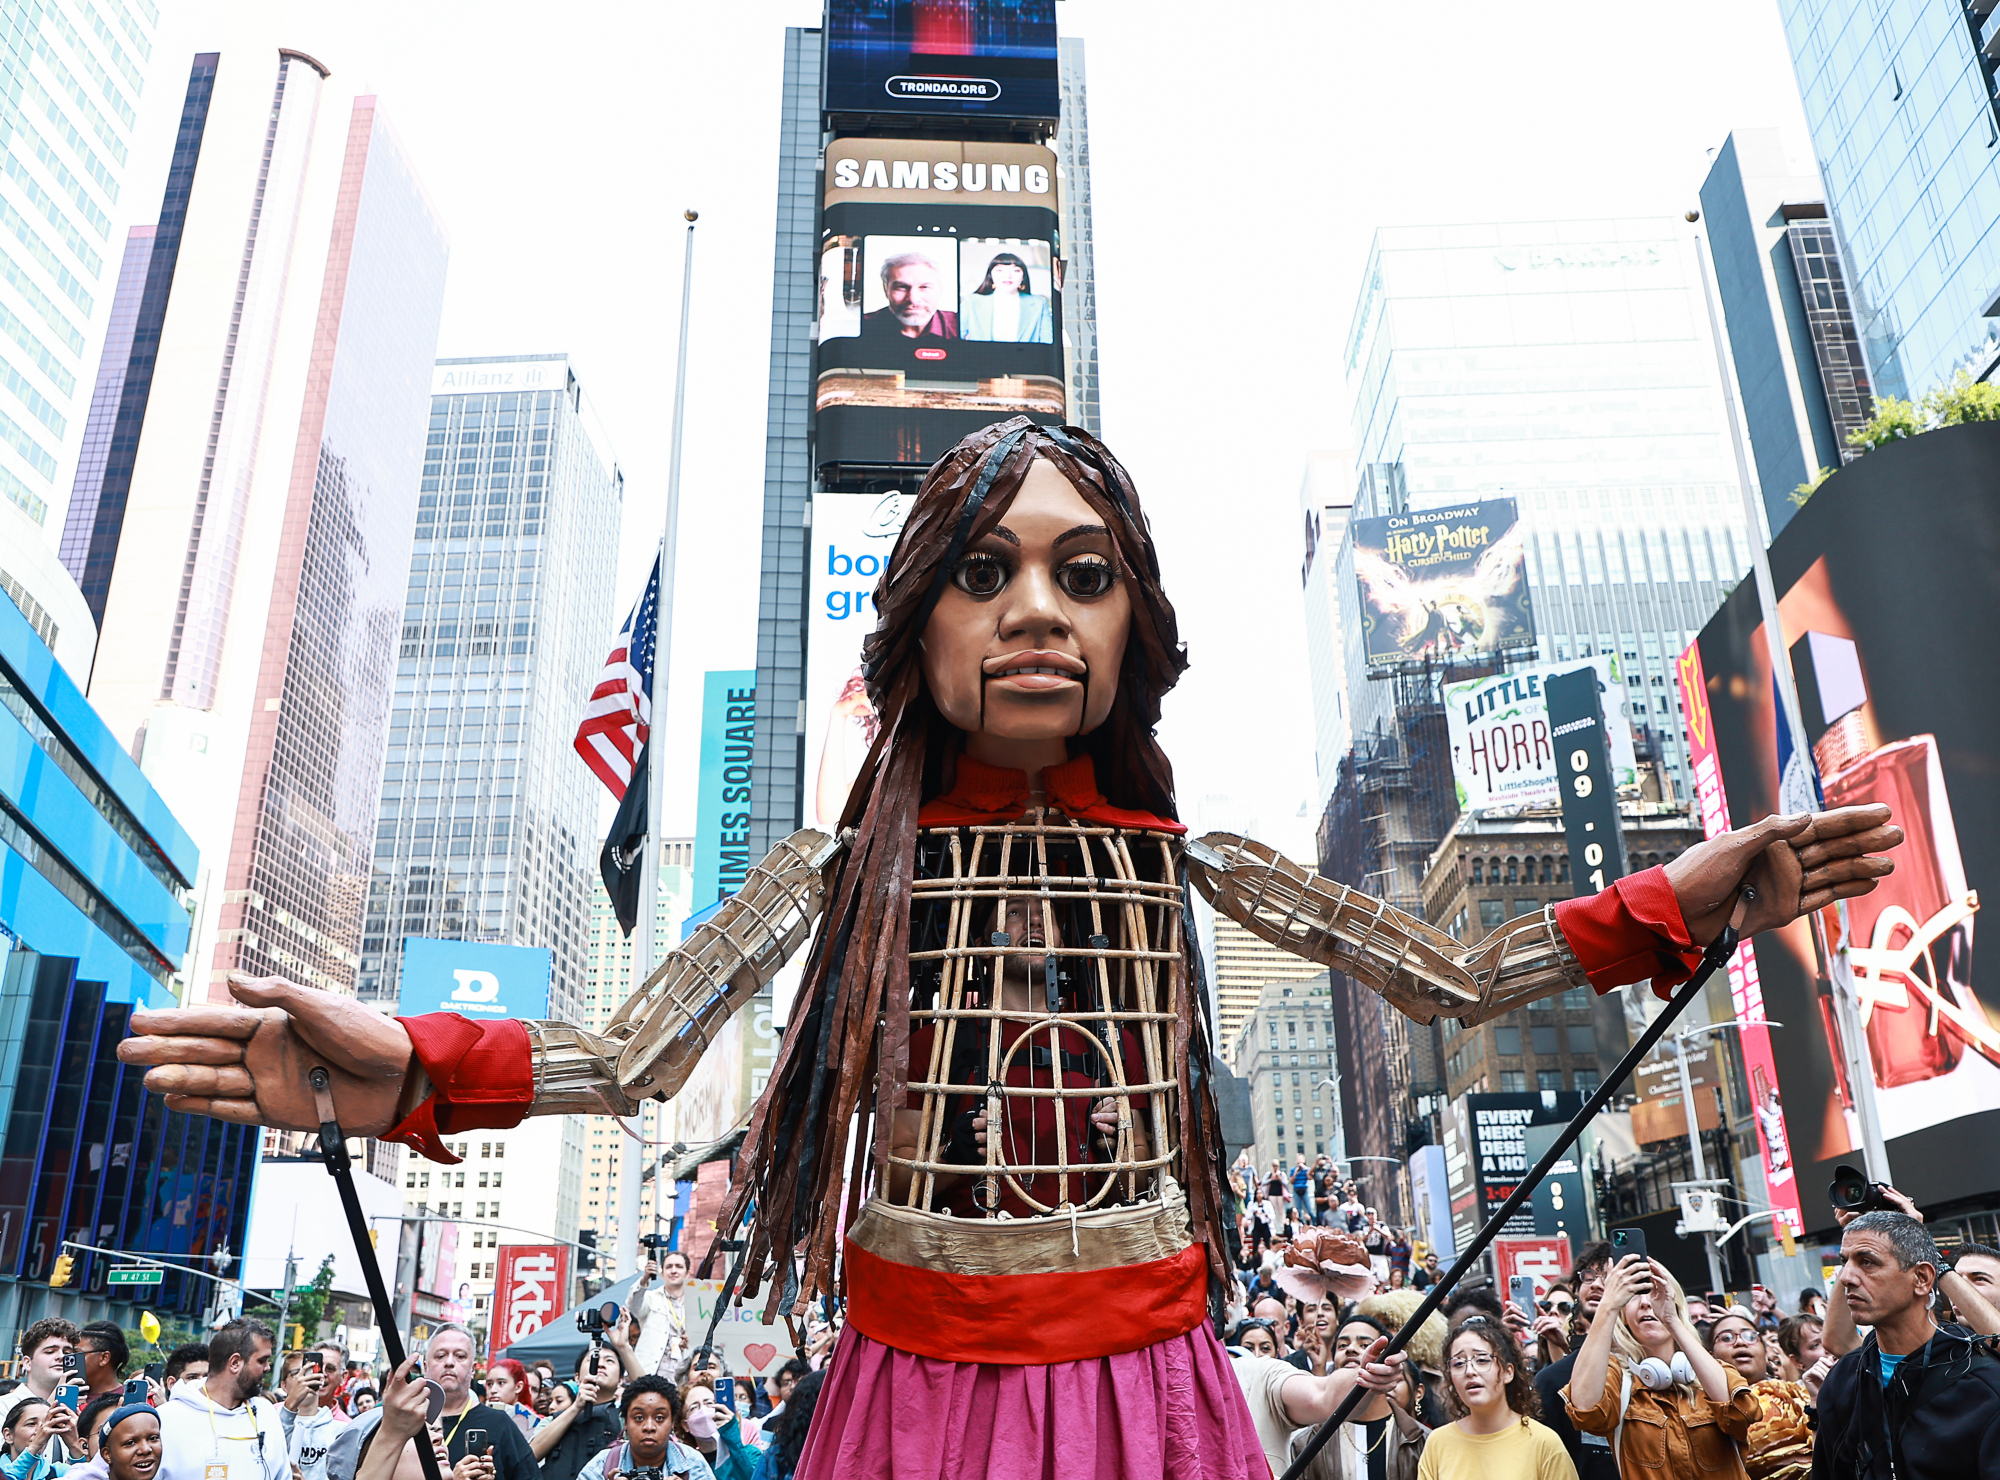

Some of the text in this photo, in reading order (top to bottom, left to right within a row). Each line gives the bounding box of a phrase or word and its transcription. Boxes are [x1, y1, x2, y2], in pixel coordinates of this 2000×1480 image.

[900, 82, 987, 95] TRONDAO.ORG
[834, 158, 1050, 194] SAMSUNG
[442, 370, 514, 387] Allianz
[1388, 507, 1480, 529] ON BROADWAY
[1384, 524, 1490, 563] Harry Potter
[828, 545, 891, 576] bo
[1408, 556, 1442, 567] CURSED
[1443, 551, 1472, 562] CHILD
[826, 591, 878, 620] gr
[1465, 675, 1541, 725] LITTLE
[1499, 775, 1559, 791] LittleShopNY
[717, 688, 756, 899] TIMES SQUARE
[440, 1001, 508, 1013] DAKTRONICS
[751, 1003, 781, 1119] ELLO!
[1476, 1109, 1534, 1125] EVERY
[1479, 1141, 1527, 1156] DESE
[1482, 1157, 1496, 1172] A
[1498, 1156, 1528, 1171] HO
[130, 1273, 139, 1281] 47
